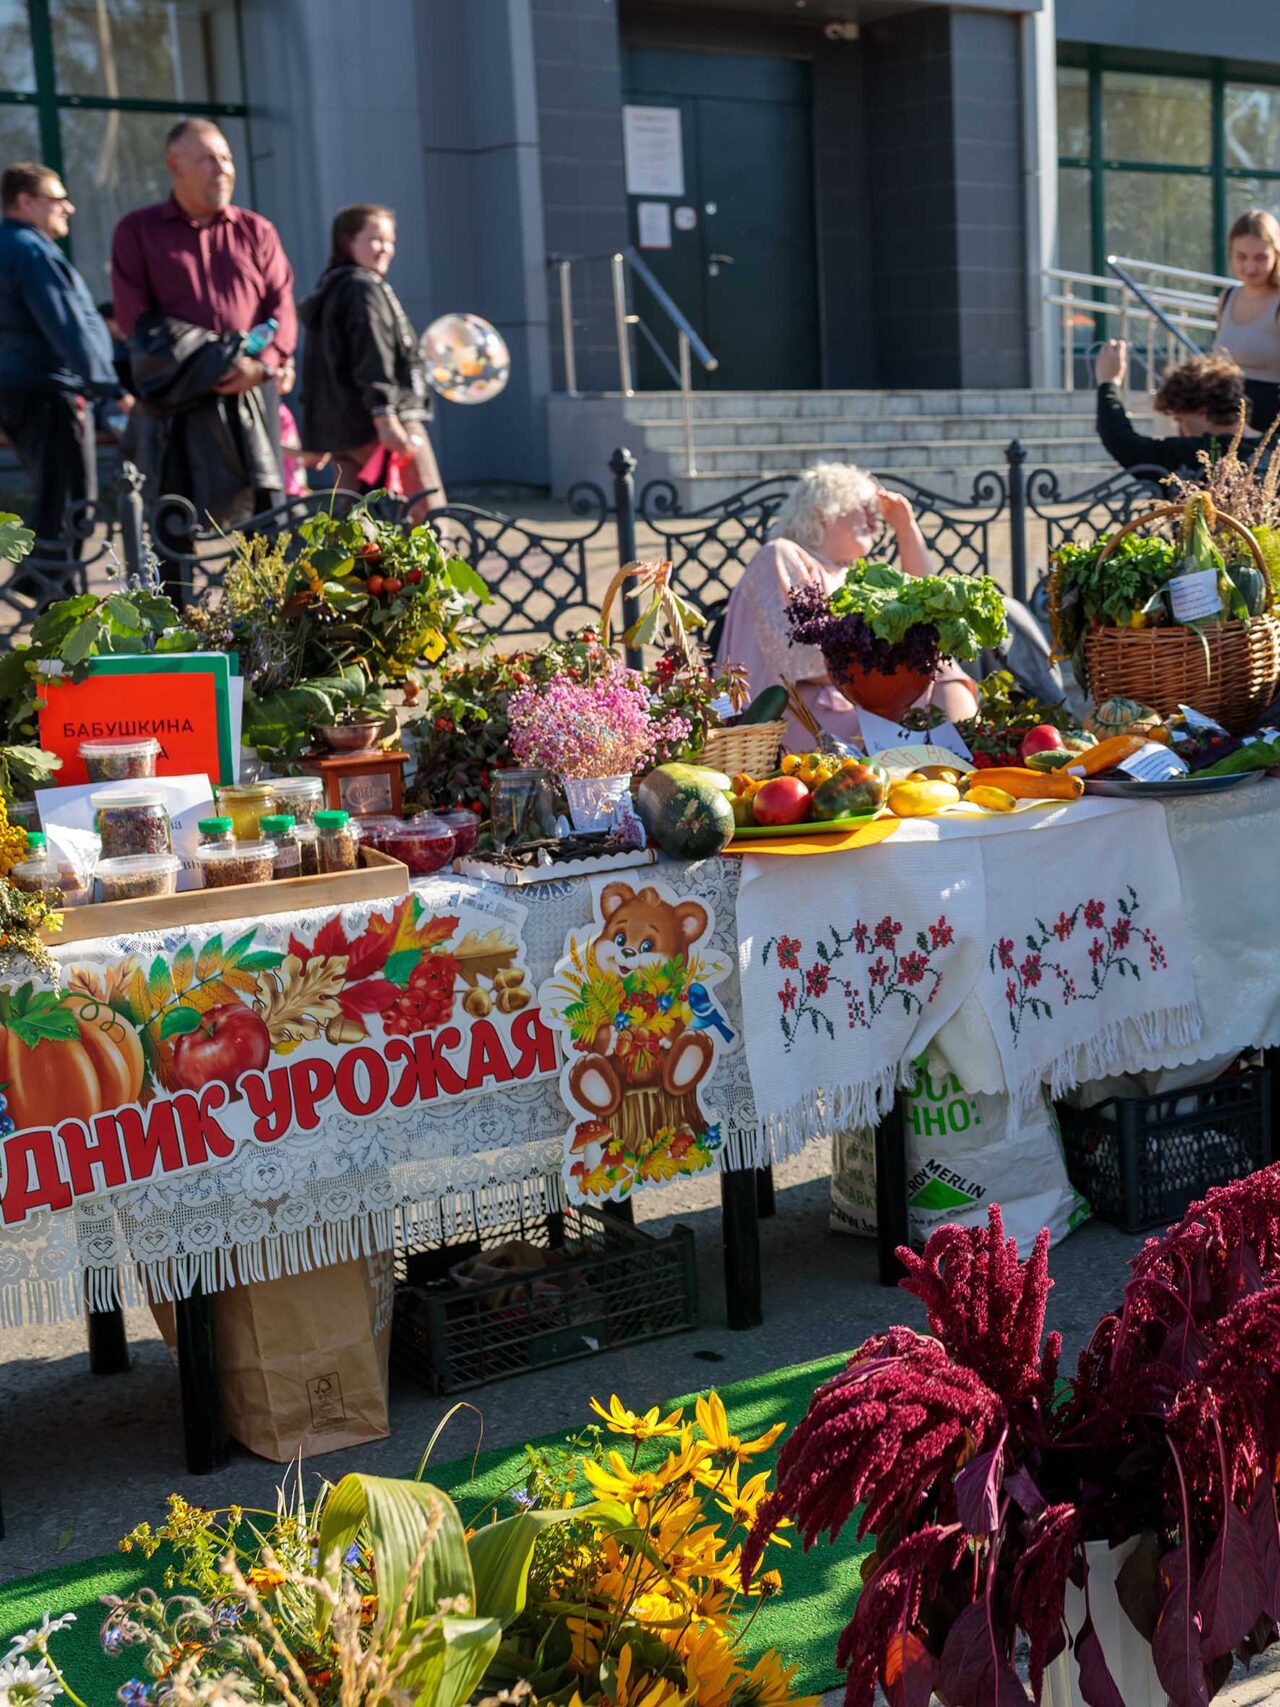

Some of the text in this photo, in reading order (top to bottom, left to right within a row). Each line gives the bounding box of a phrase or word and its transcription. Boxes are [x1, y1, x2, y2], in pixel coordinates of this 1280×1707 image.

[63, 719, 194, 738] БАБУШКИНА
[0, 1008, 557, 1226] ДНИК УРОЖАЯ
[907, 1168, 931, 1197] ROY
[925, 1158, 987, 1198] MERLIN
